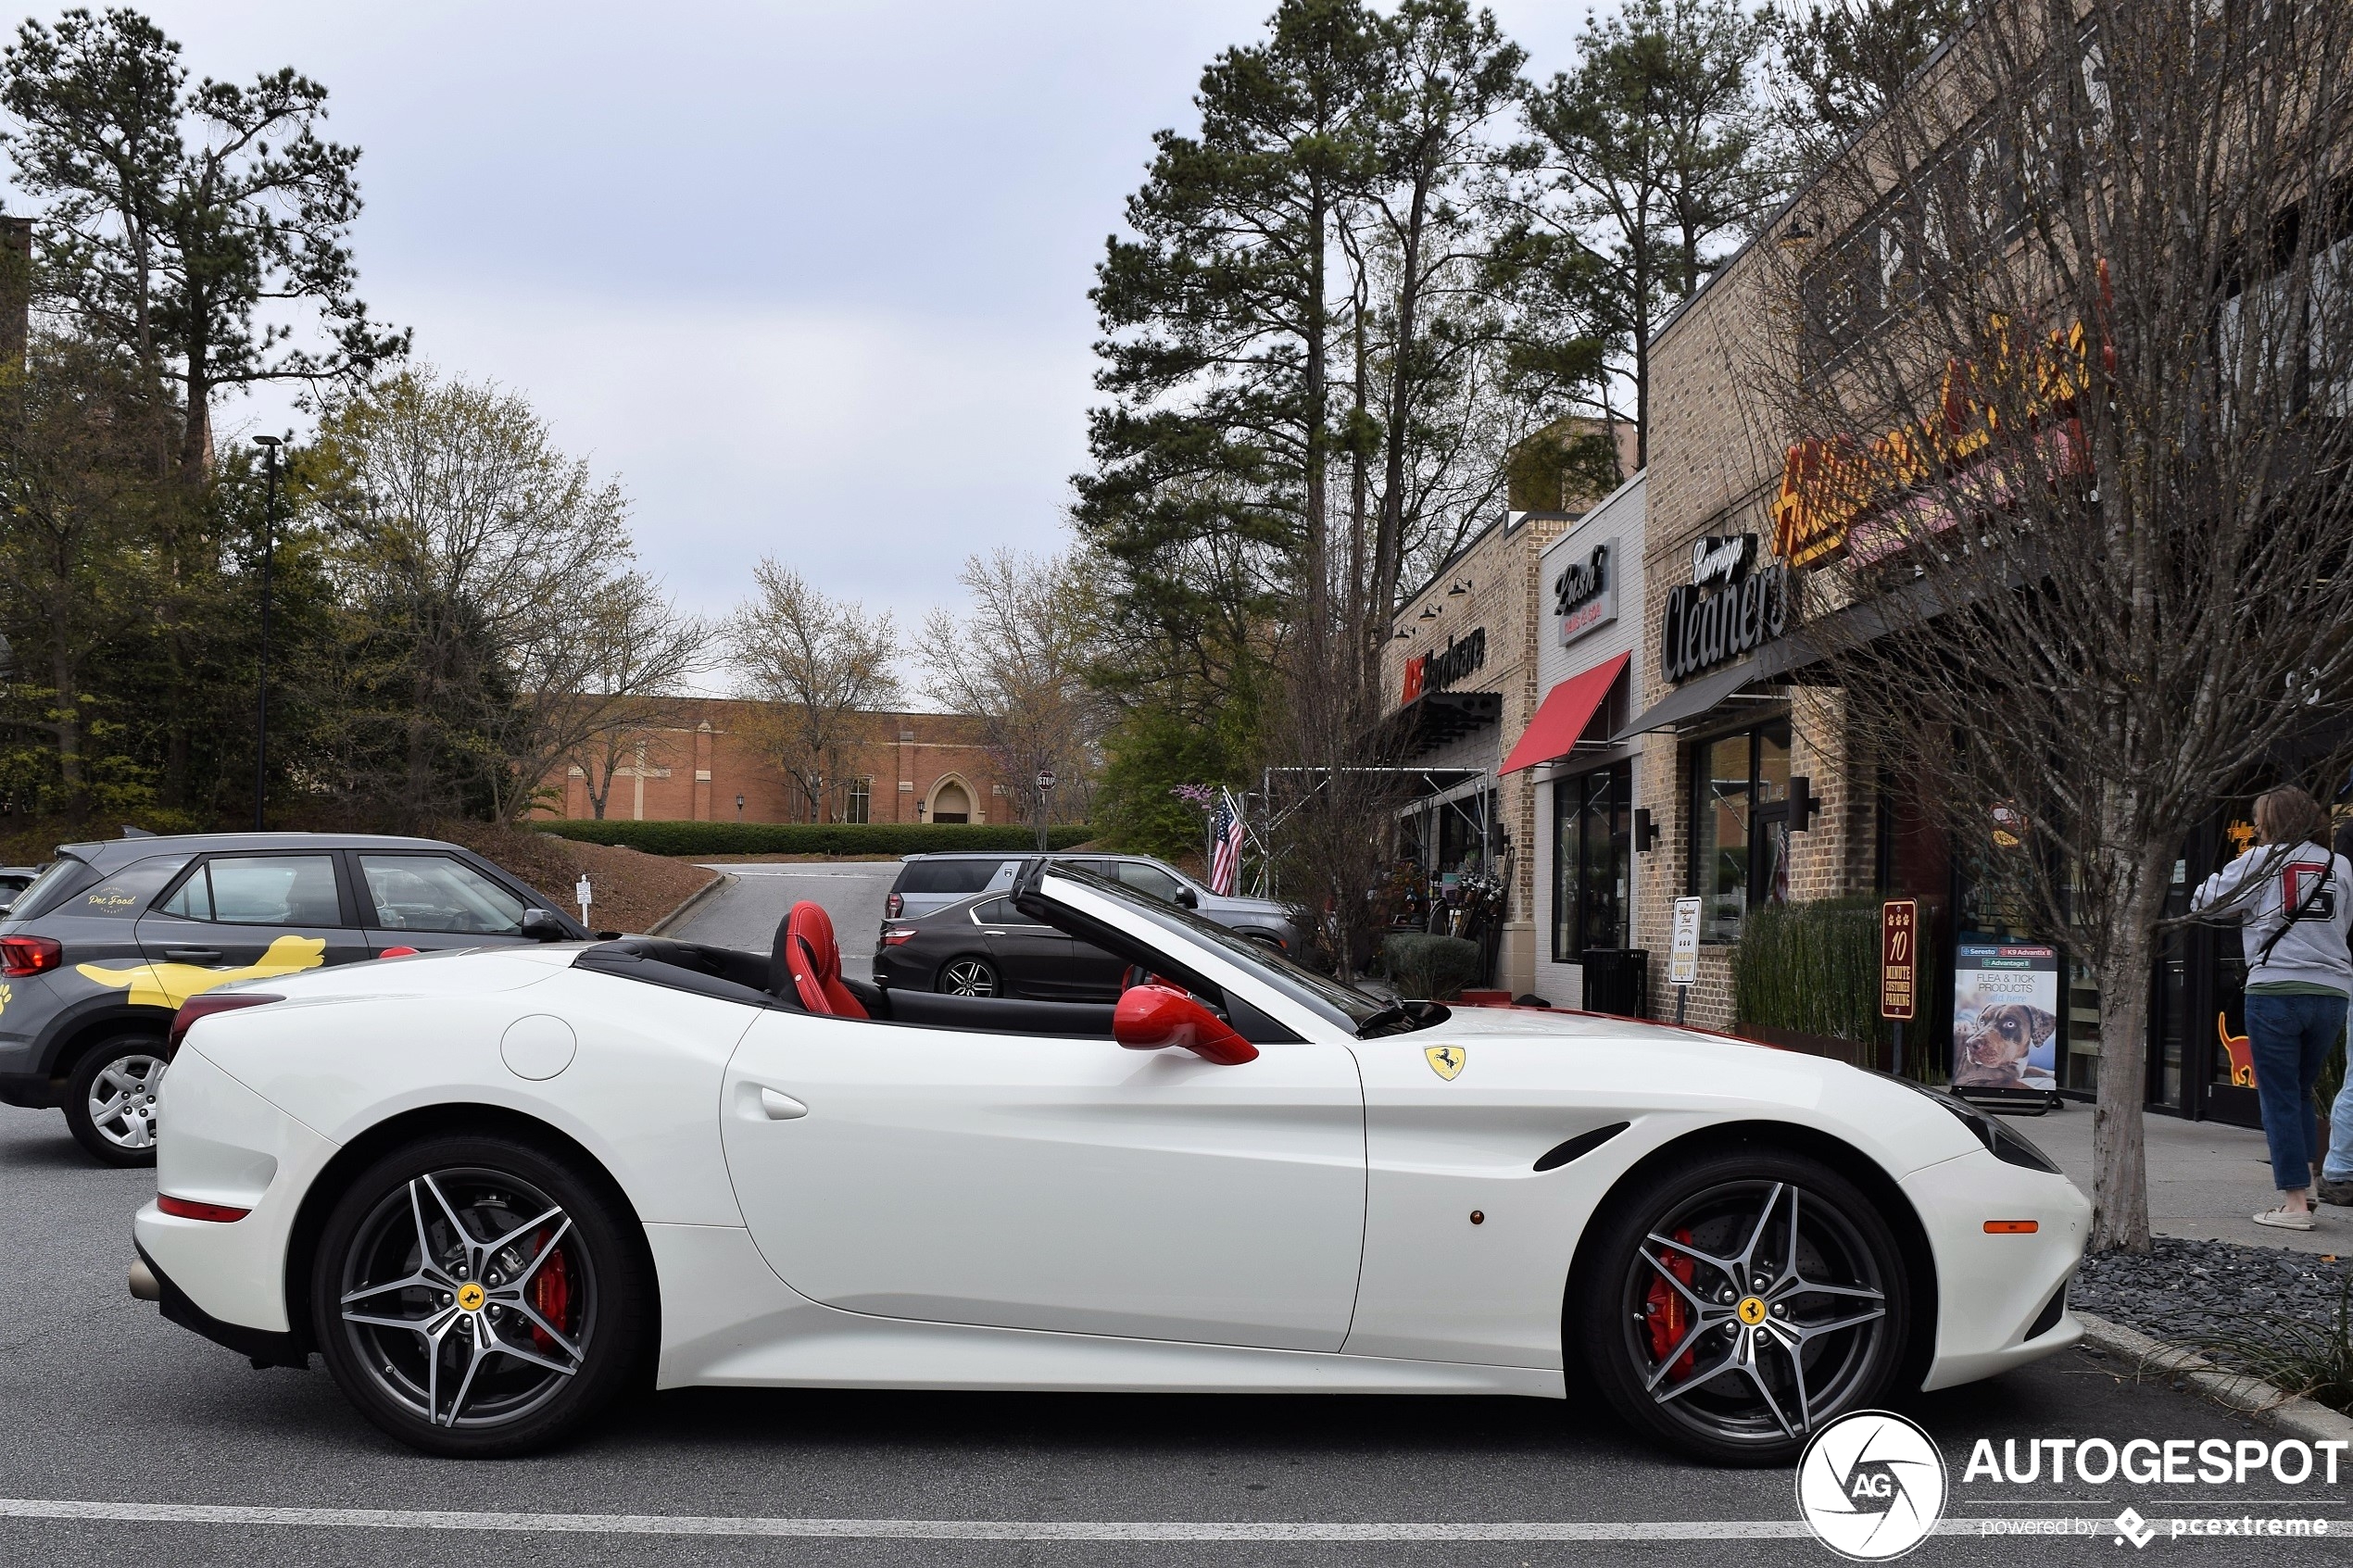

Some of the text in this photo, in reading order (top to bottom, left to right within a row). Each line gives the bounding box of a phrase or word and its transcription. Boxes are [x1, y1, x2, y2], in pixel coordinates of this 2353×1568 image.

[1693, 533, 1744, 588] Carriage
[1588, 602, 1603, 622] spa
[1662, 555, 1789, 684] Cleaners
[88, 895, 136, 906] Pet Food
[1890, 930, 1907, 961] 10
[1886, 965, 1910, 980] MINUTE
[1977, 973, 2035, 984] FLEA & TICK
[1886, 981, 1909, 993] CUSTOMER
[1979, 983, 2033, 993] PRODUCTS
[1885, 993, 1909, 1007] PARKING
[2006, 995, 2027, 1003] here
